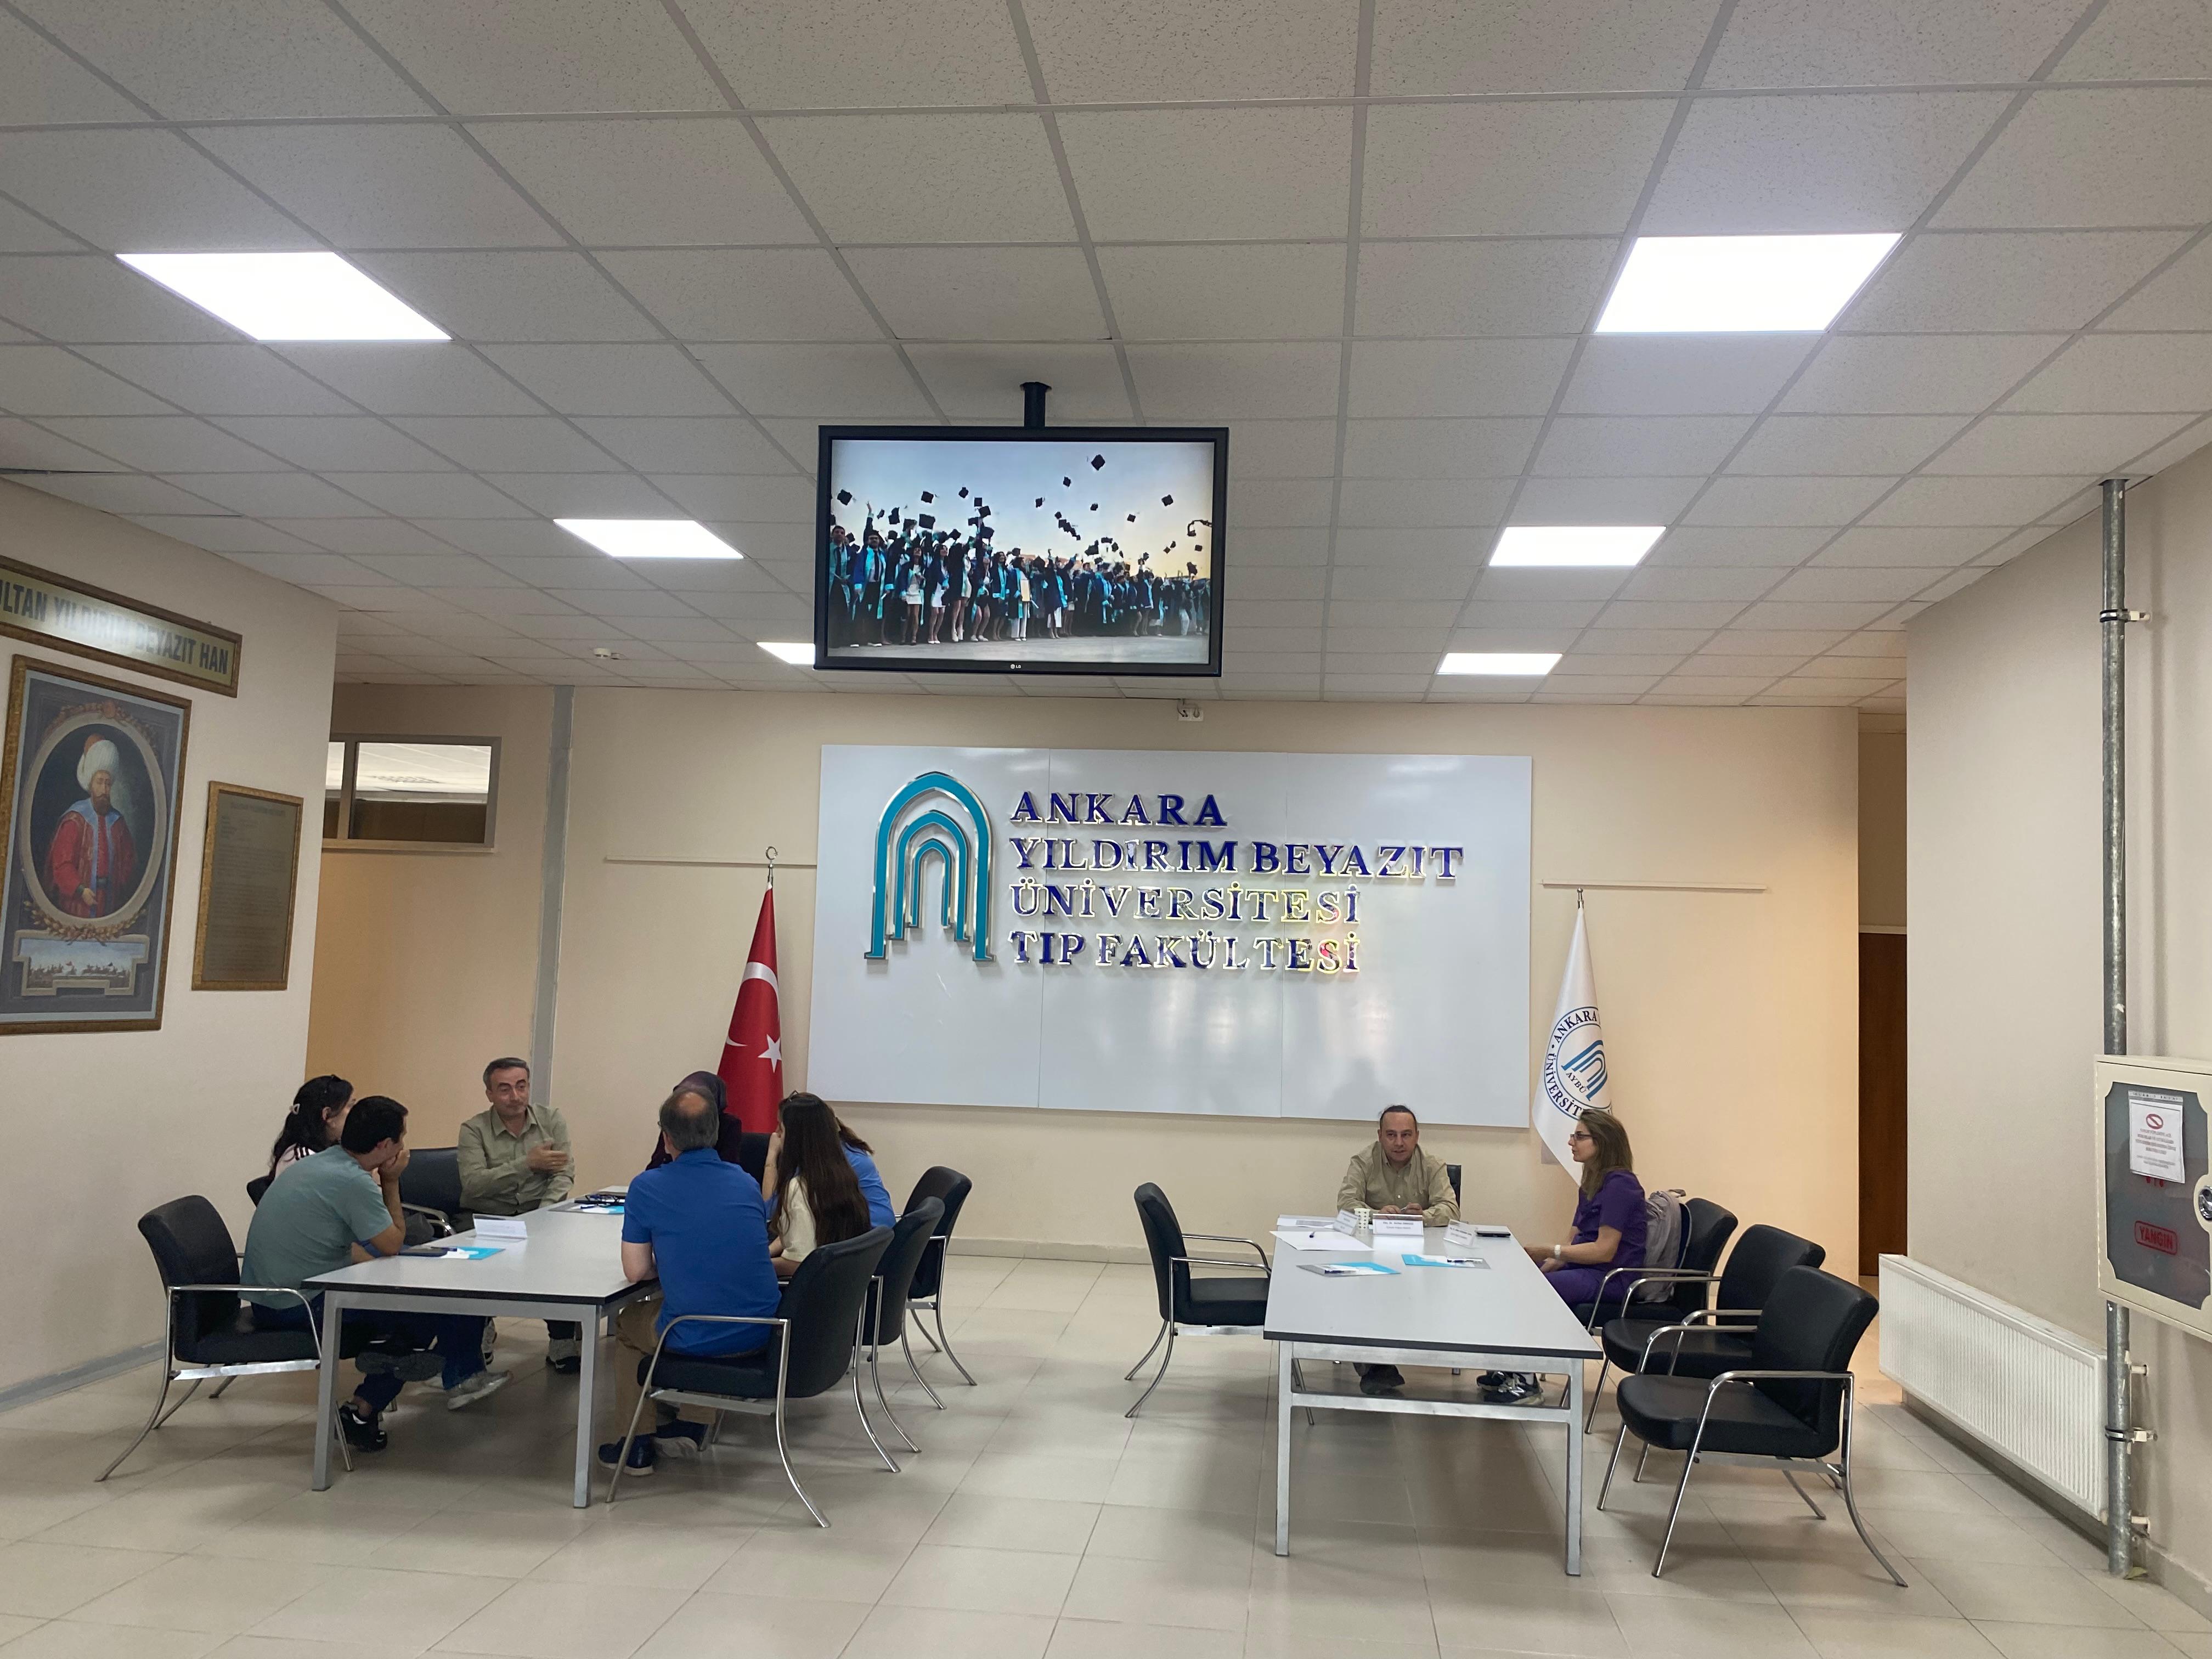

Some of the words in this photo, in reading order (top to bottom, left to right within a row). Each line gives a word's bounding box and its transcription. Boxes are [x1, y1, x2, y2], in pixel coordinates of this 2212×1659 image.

[0, 579, 48, 622] LTAN
[199, 642, 229, 675] HAN
[1010, 791, 1228, 827] ANKARA
[1009, 837, 1239, 873] YILDIRIM
[1250, 841, 1464, 879] BEYAZIT
[1009, 877, 1361, 924] ÜNİVERSİTESİ
[1008, 930, 1086, 966] TIP
[1095, 928, 1361, 974] FAKÜLTESİ
[1554, 1010, 1598, 1043] ANKARA
[1545, 1053, 1582, 1116] ÜNİVERSİT
